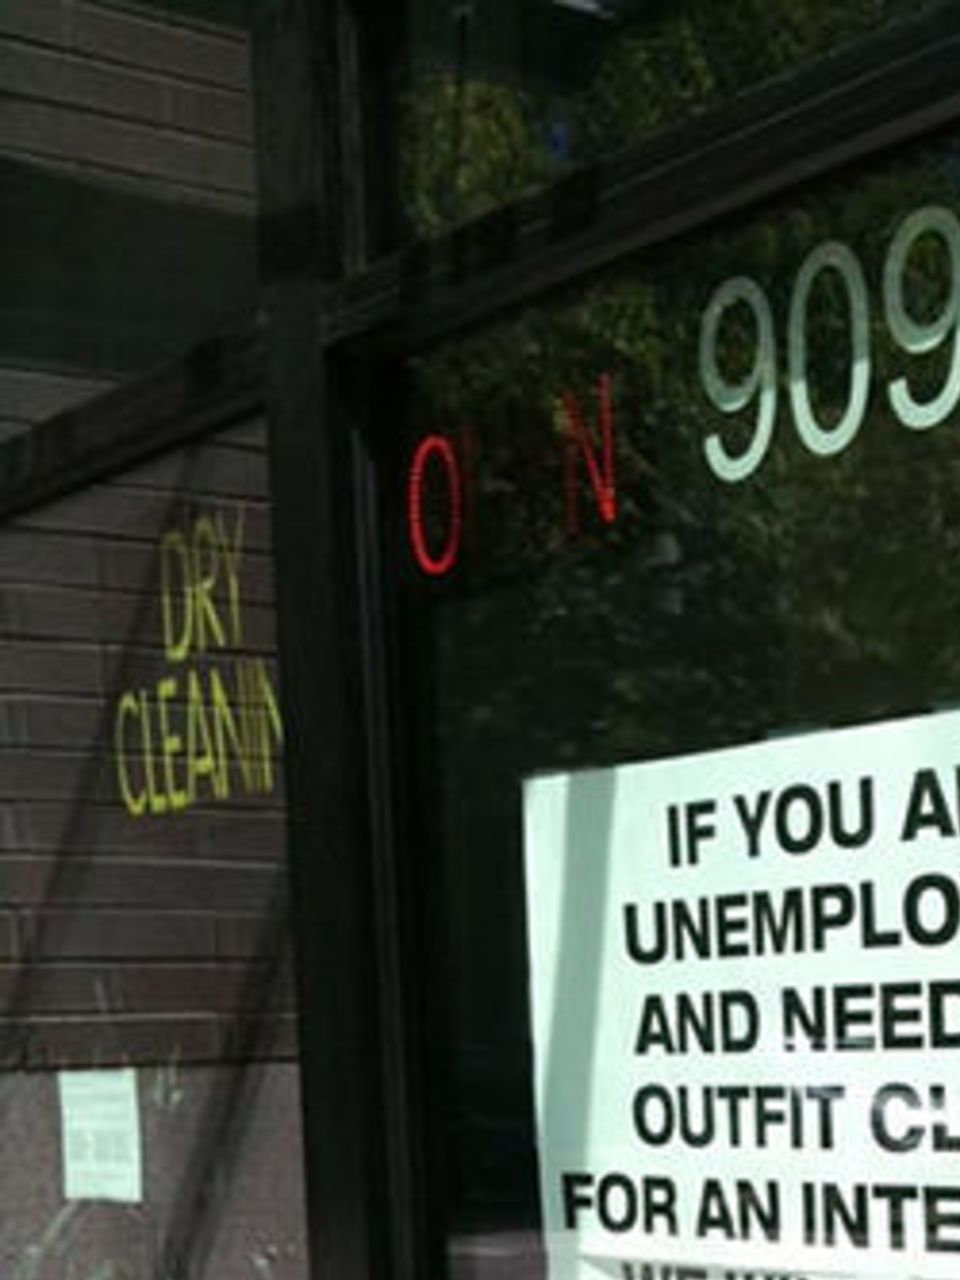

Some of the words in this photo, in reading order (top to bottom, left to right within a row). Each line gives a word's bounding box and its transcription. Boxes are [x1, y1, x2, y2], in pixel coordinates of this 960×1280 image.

[159, 504, 245, 662] DRY
[666, 799, 717, 869] IF
[733, 775, 875, 860] YOU
[633, 989, 762, 1056] AND
[631, 1083, 846, 1150] OUTFIT
[560, 1172, 679, 1237] FOR
[696, 1178, 781, 1242] AN
